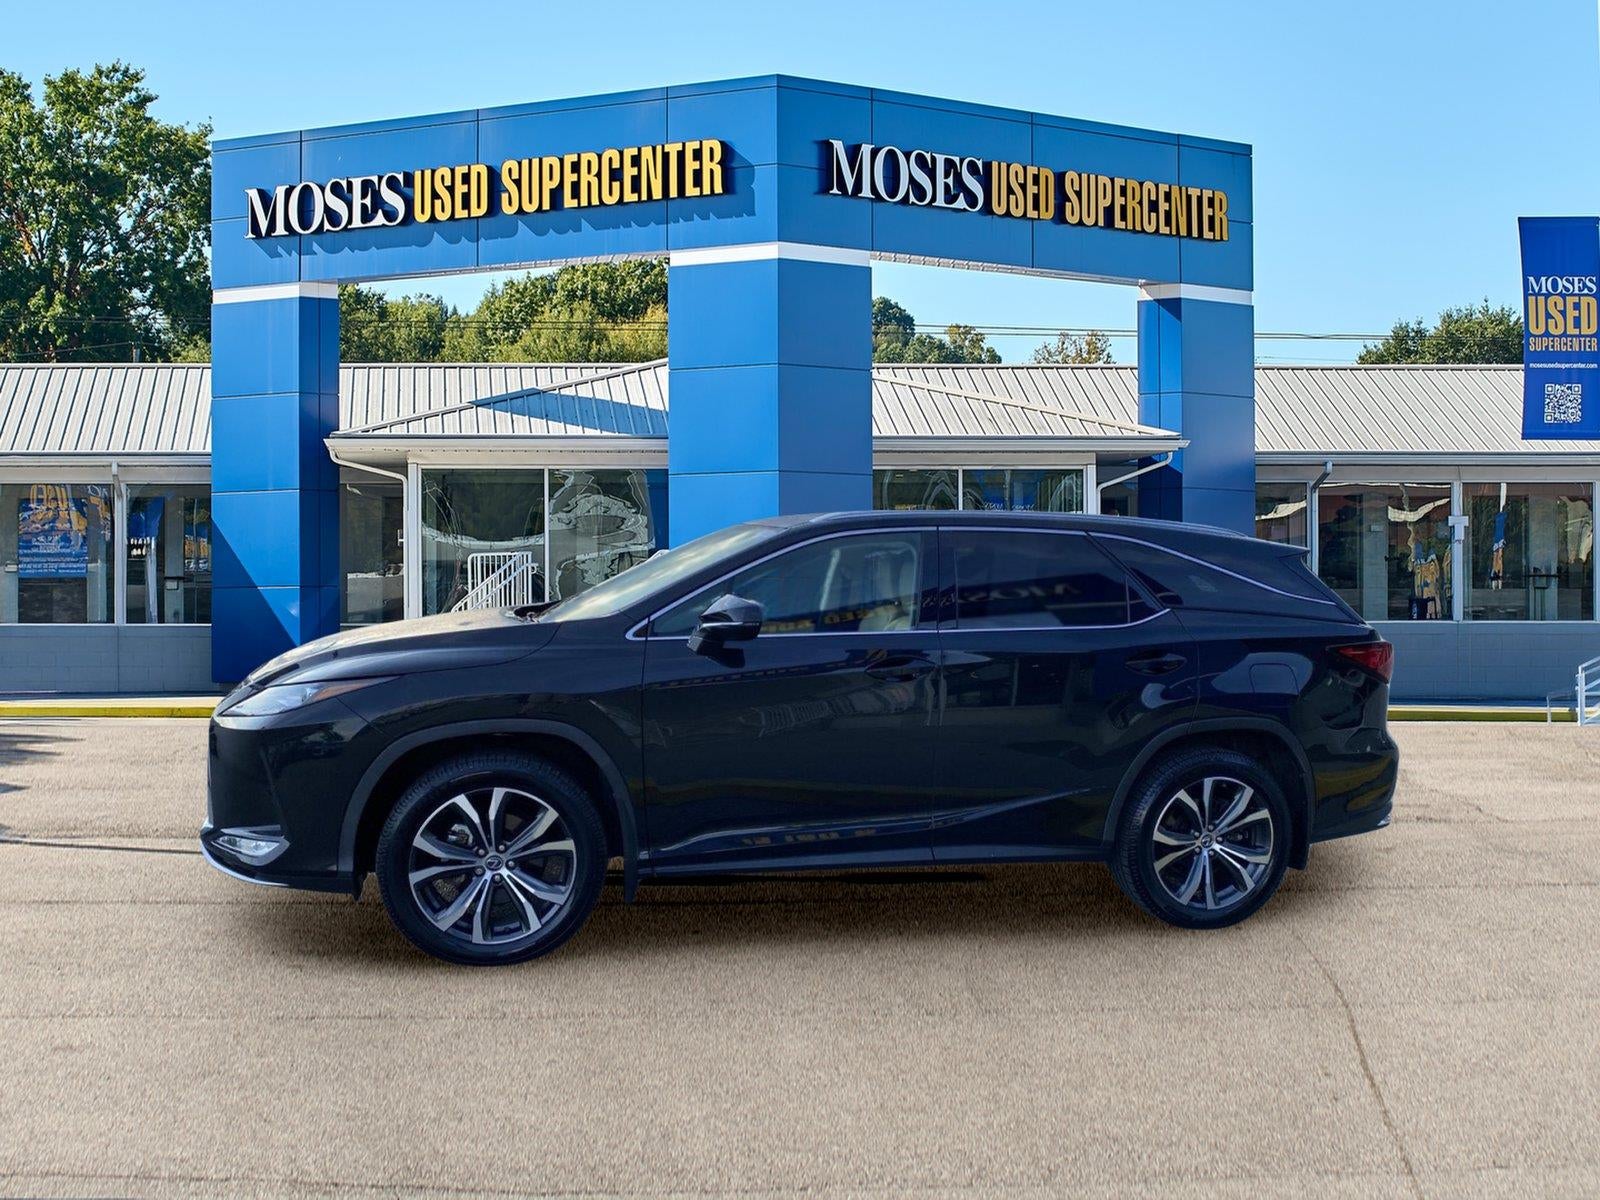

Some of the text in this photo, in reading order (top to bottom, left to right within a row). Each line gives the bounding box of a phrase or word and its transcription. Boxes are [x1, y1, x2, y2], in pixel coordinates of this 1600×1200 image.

[245, 139, 725, 239] MOSES USED SUPERCENTER
[829, 139, 1229, 241] MOSES USED SUPERCENTER
[1527, 276, 1597, 294] MOSES
[1528, 296, 1598, 335] USED
[1529, 337, 1598, 352] SUPERCENTER
